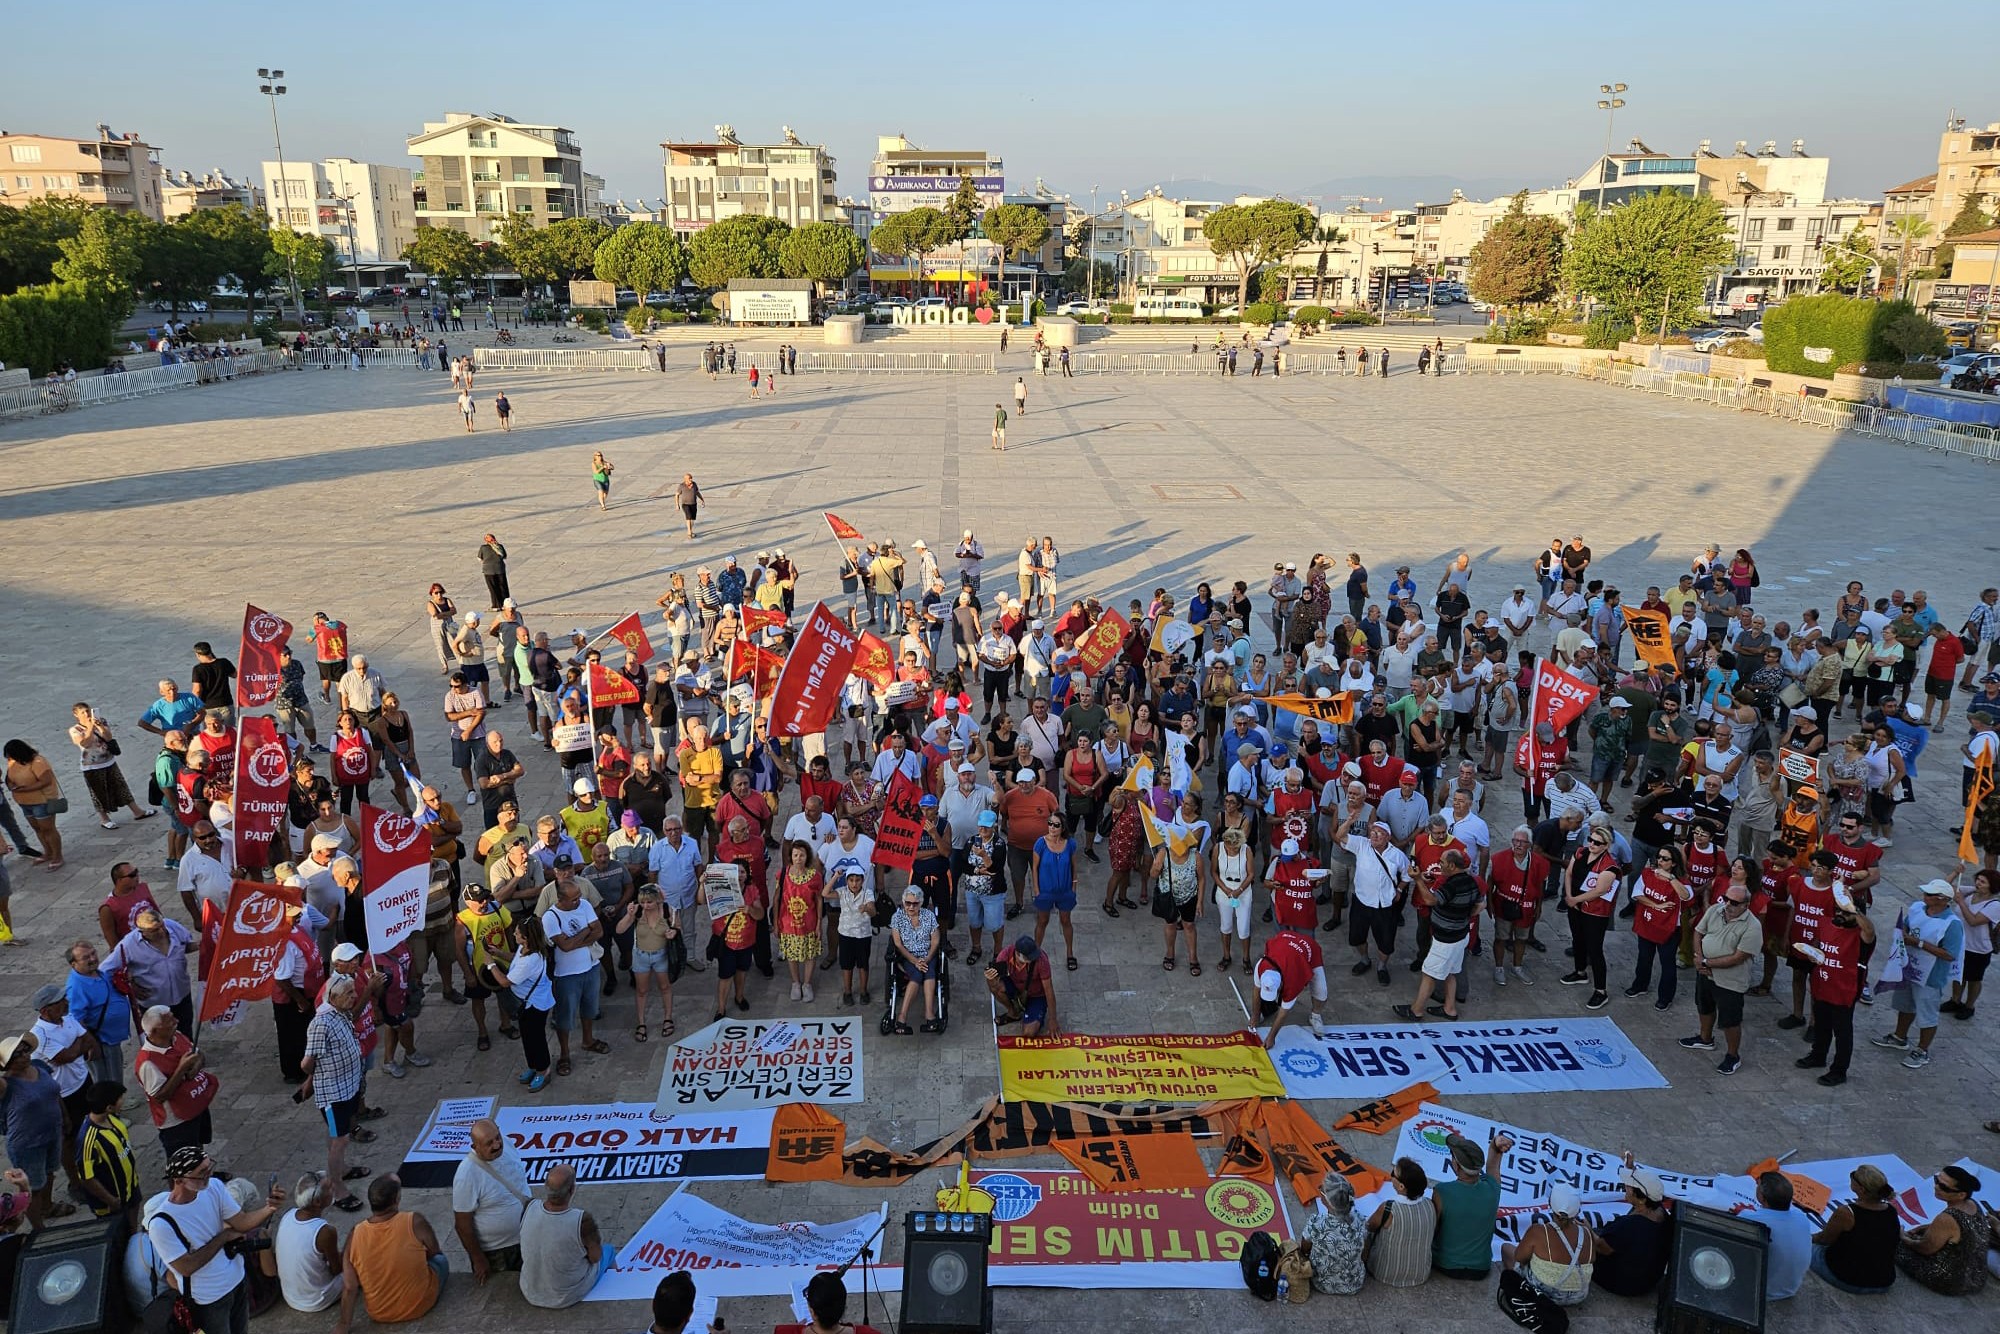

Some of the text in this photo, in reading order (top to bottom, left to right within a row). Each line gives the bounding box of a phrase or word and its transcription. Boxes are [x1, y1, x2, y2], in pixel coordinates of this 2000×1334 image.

[886, 178, 932, 190] AMERİKANCA
[259, 618, 276, 629] TİP
[814, 616, 855, 653] DİSK
[1088, 645, 1104, 660] EMEK
[245, 672, 280, 682] TÜRKİYE
[1540, 672, 1590, 705] DİSK
[596, 694, 613, 702] EMEK
[210, 752, 235, 763] TÜRKİ
[261, 754, 284, 766] TİP
[348, 753, 364, 764] TİP
[242, 800, 288, 813] TÜRKİY
[270, 815, 282, 827] İŞ
[386, 816, 412, 832] TİP
[244, 830, 274, 842] PART
[883, 824, 915, 839] EMEK
[378, 888, 420, 912] TÜRKİYE
[1285, 889, 1312, 899] GENEL
[1645, 886, 1667, 902] DİSK
[250, 897, 278, 914] TİP
[403, 900, 420, 918] İŞÇİ
[1293, 902, 1303, 910] İŞ
[1799, 904, 1824, 916] DİSK
[1644, 910, 1652, 922] İŞ
[1795, 916, 1818, 928] GENE
[1802, 930, 1814, 940] İŞ
[1823, 958, 1843, 969] NEL
[1820, 968, 1829, 981] İŞ
[1205, 1033, 1244, 1046] EMEK
[1446, 1026, 1560, 1040] AYDIN
[788, 1037, 852, 1052] SERVE
[1074, 1034, 1104, 1048] İLÇE
[1109, 1036, 1147, 1048] DİDİM
[1149, 1035, 1204, 1048] PARTİSİ
[672, 1051, 853, 1072] PATRONLARDAN
[1094, 1049, 1182, 1064] BİRLEŞİNİZ
[1327, 1045, 1410, 1078] SEN
[1432, 1040, 1585, 1082] EMEKLİ
[672, 1066, 853, 1088] GERİ ÇEKİLSİN
[1106, 1067, 1160, 1080] EZİLEN
[1165, 1067, 1189, 1079] VE
[1190, 1065, 1259, 1080] İŞÇİLERİ
[676, 1082, 852, 1104] ZAMLAR
[1066, 1081, 1218, 1096] BÜTÜN ÜLKELERİN
[521, 1112, 643, 1124] TÜRKİYE İŞÇİ PARTİSİ
[506, 1126, 738, 1153] HALK ÖDÜYO
[607, 1153, 683, 1178] SARAY
[1658, 1174, 1714, 1191] DİD
[990, 1185, 1042, 1201] KES
[1088, 1202, 1160, 1220] Didim
